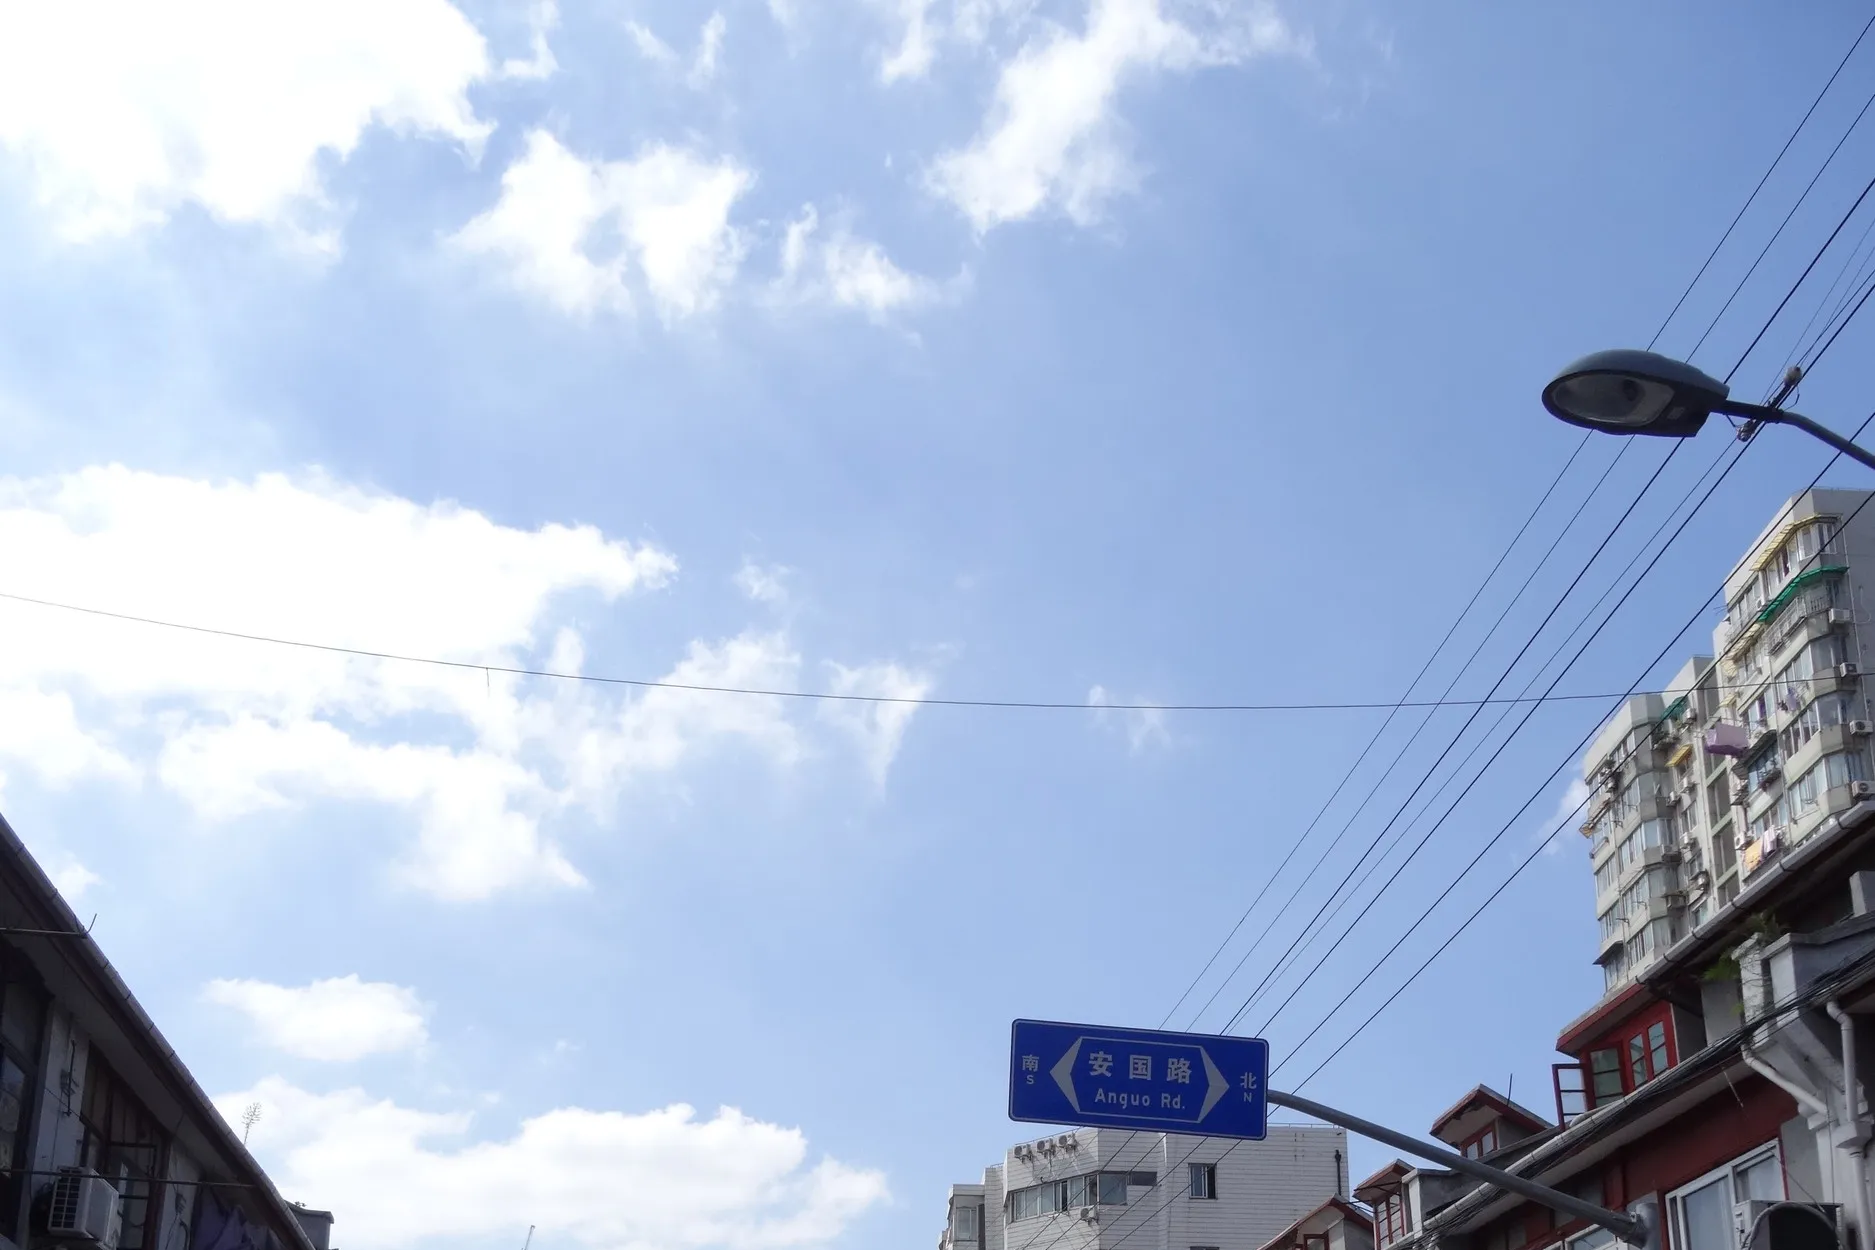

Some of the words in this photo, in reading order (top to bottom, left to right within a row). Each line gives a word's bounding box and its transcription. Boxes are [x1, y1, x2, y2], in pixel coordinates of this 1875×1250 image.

[1021, 1054, 1040, 1073] 南
[1089, 1051, 1192, 1084] 安国路
[1026, 1074, 1035, 1085] S
[1240, 1072, 1257, 1090] 北
[1094, 1087, 1151, 1109] Anguo
[1160, 1094, 1186, 1109] Rd.
[1243, 1093, 1252, 1103] N
